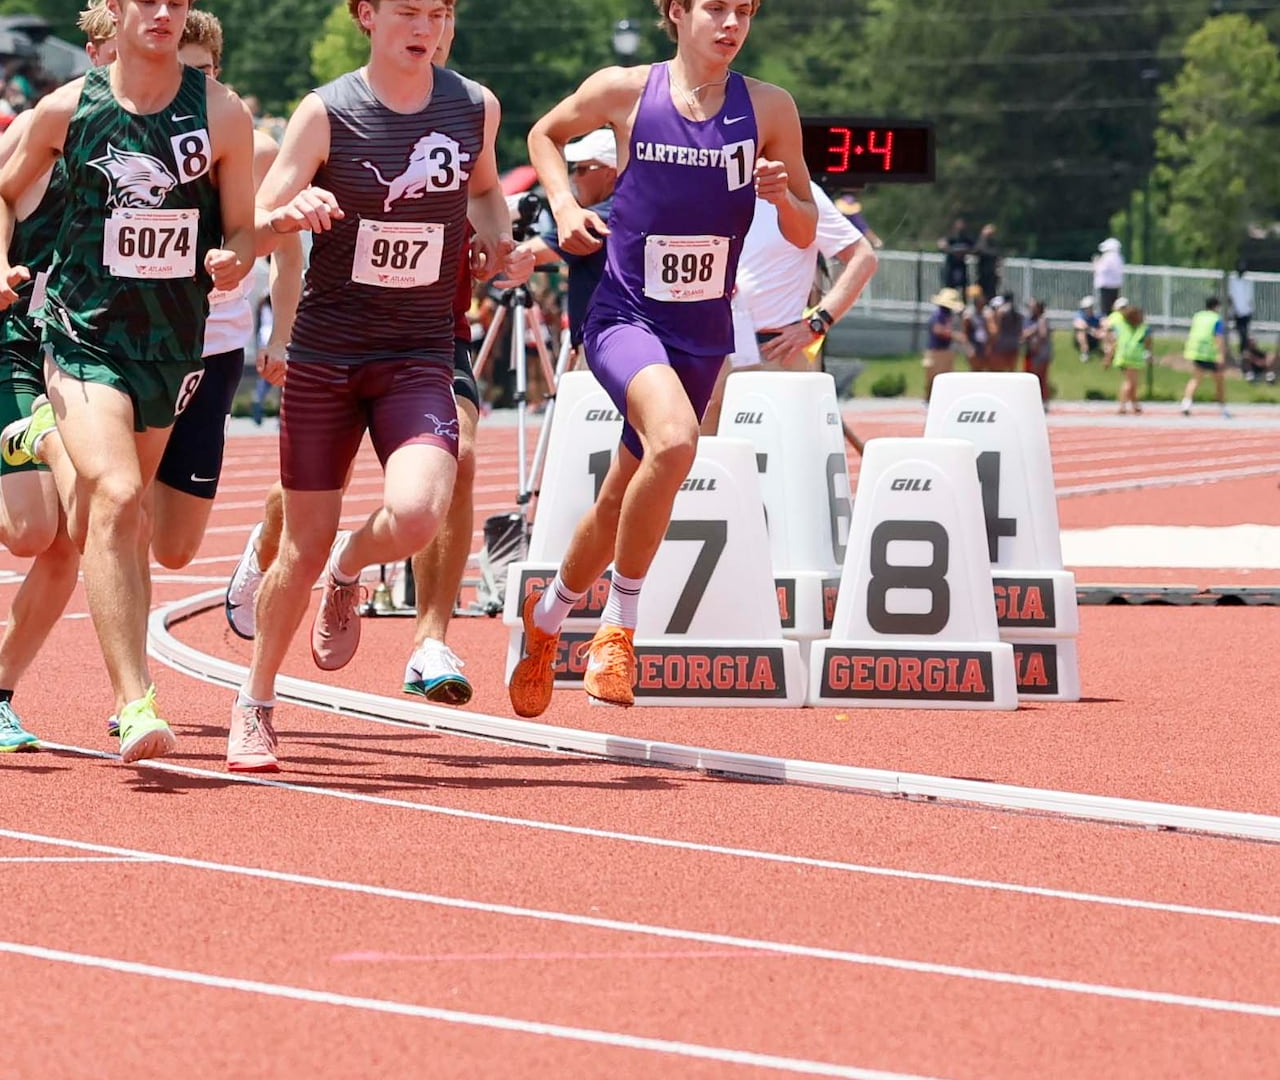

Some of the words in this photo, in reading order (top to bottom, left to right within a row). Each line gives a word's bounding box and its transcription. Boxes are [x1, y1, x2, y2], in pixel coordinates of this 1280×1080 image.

[178, 135, 208, 177] 8
[429, 146, 455, 188] 3
[730, 145, 745, 185] 1
[118, 226, 190, 259] 6074
[370, 238, 429, 270] 987
[661, 252, 715, 284] 898
[585, 408, 623, 422] GILL
[734, 411, 764, 425] GILL
[956, 410, 997, 424] GILL
[678, 477, 717, 491] GILL
[890, 478, 933, 492] GILL
[663, 519, 728, 635] 7
[866, 518, 951, 636] 8
[827, 655, 986, 693] GEORGIA
